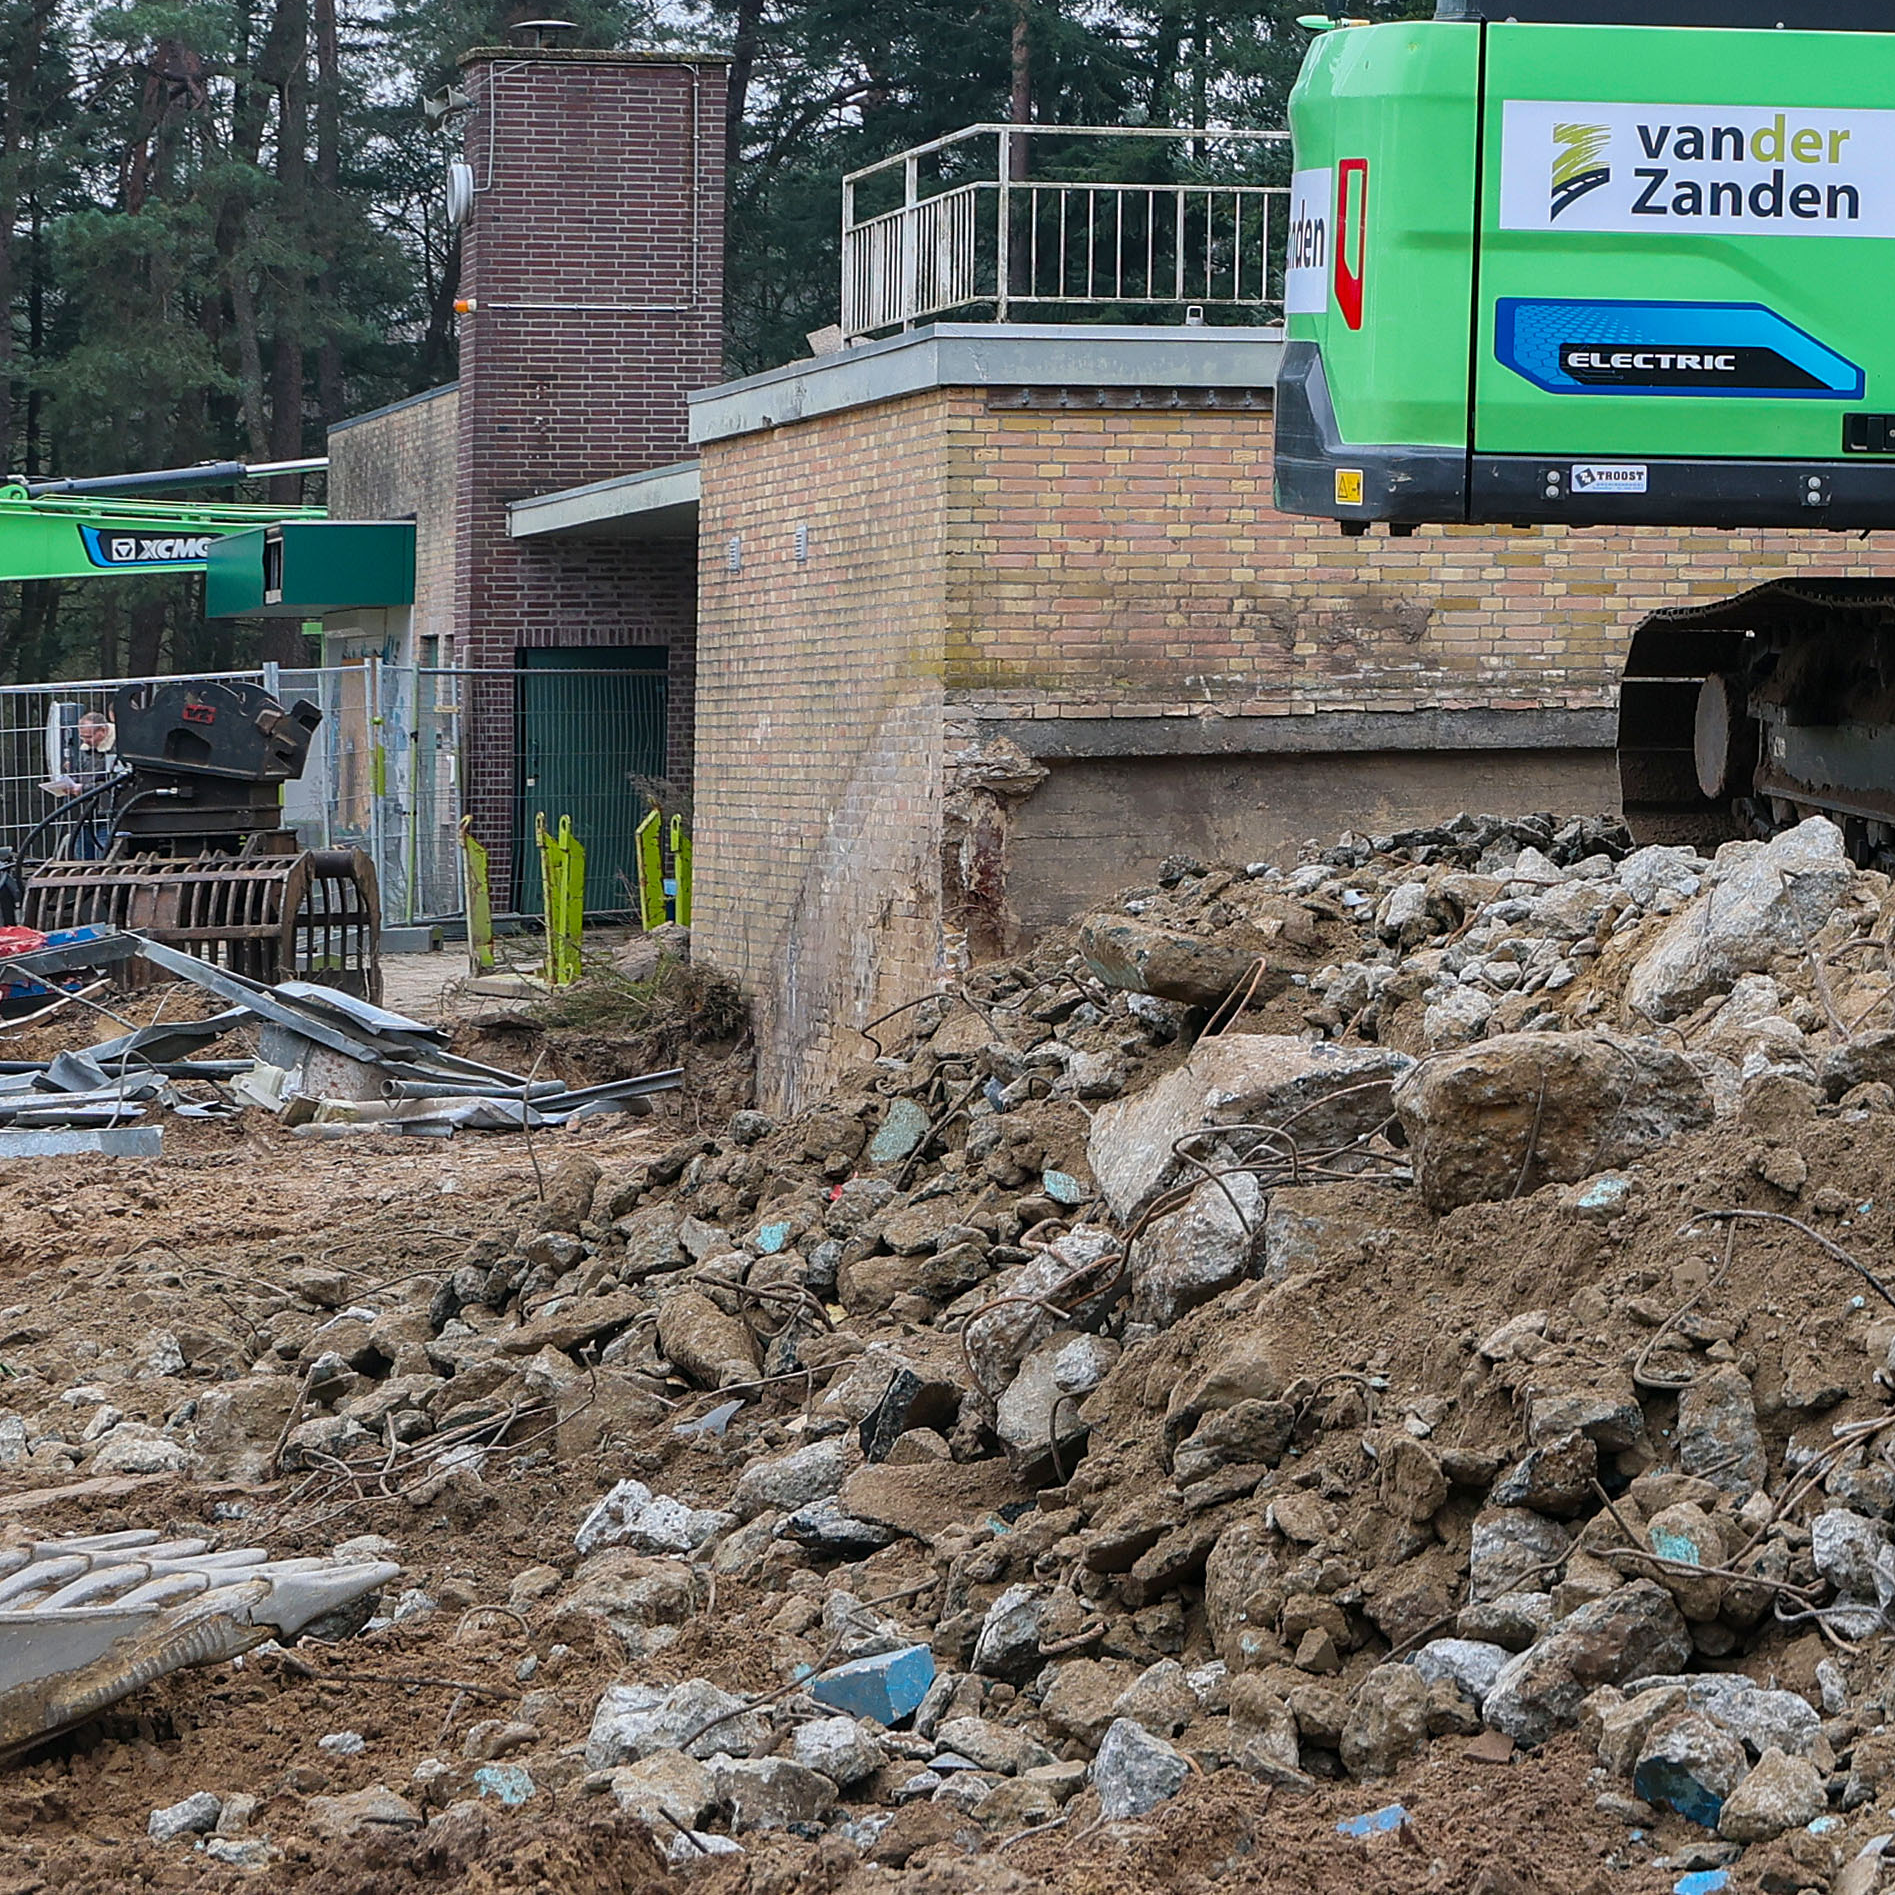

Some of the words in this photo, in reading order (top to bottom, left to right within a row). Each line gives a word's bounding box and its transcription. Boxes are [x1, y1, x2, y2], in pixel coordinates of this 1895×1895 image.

[1631, 168, 1859, 219] Zanden
[1567, 352, 1736, 370] ELECTRIC
[1597, 471, 1644, 481] TROOST
